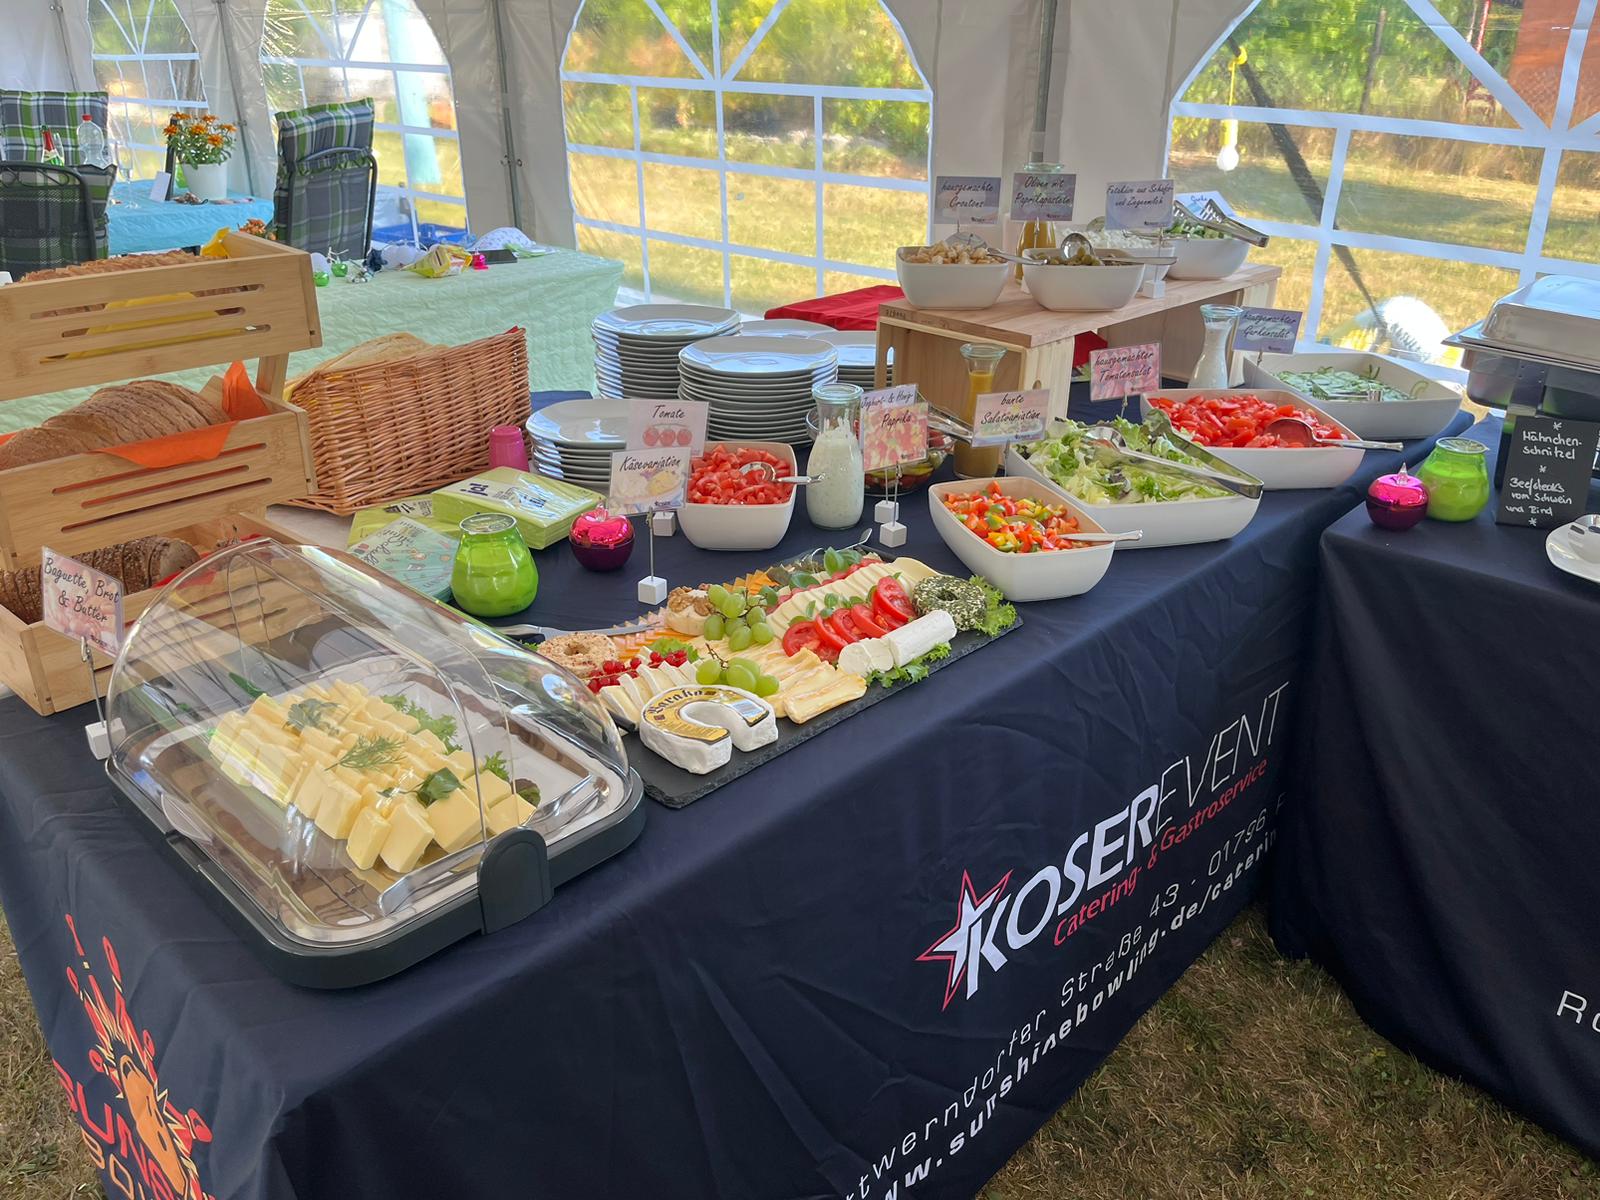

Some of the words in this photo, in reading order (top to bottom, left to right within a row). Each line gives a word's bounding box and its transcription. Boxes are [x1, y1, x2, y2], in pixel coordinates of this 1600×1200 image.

[941, 181, 993, 197] hausgemachte
[1095, 351, 1154, 369] hausgemachter
[1100, 365, 1153, 384] Tomatensalat
[1001, 393, 1024, 406] bunte
[652, 404, 685, 419] Tomate
[881, 409, 912, 432] Paprika
[981, 410, 1041, 426] Salatvariation
[620, 455, 681, 473] Käsevariation
[1511, 491, 1530, 500] vom
[1534, 493, 1573, 505] Schwein
[1505, 505, 1524, 513] und
[1528, 505, 1553, 516] Rind
[95, 579, 120, 603] Brot
[58, 590, 70, 608] &
[73, 595, 108, 622] Butter
[1147, 849, 1158, 871] &
[1160, 758, 1267, 852] Gastroservice
[1061, 924, 1142, 1007] Straße
[1149, 883, 1179, 919] 43
